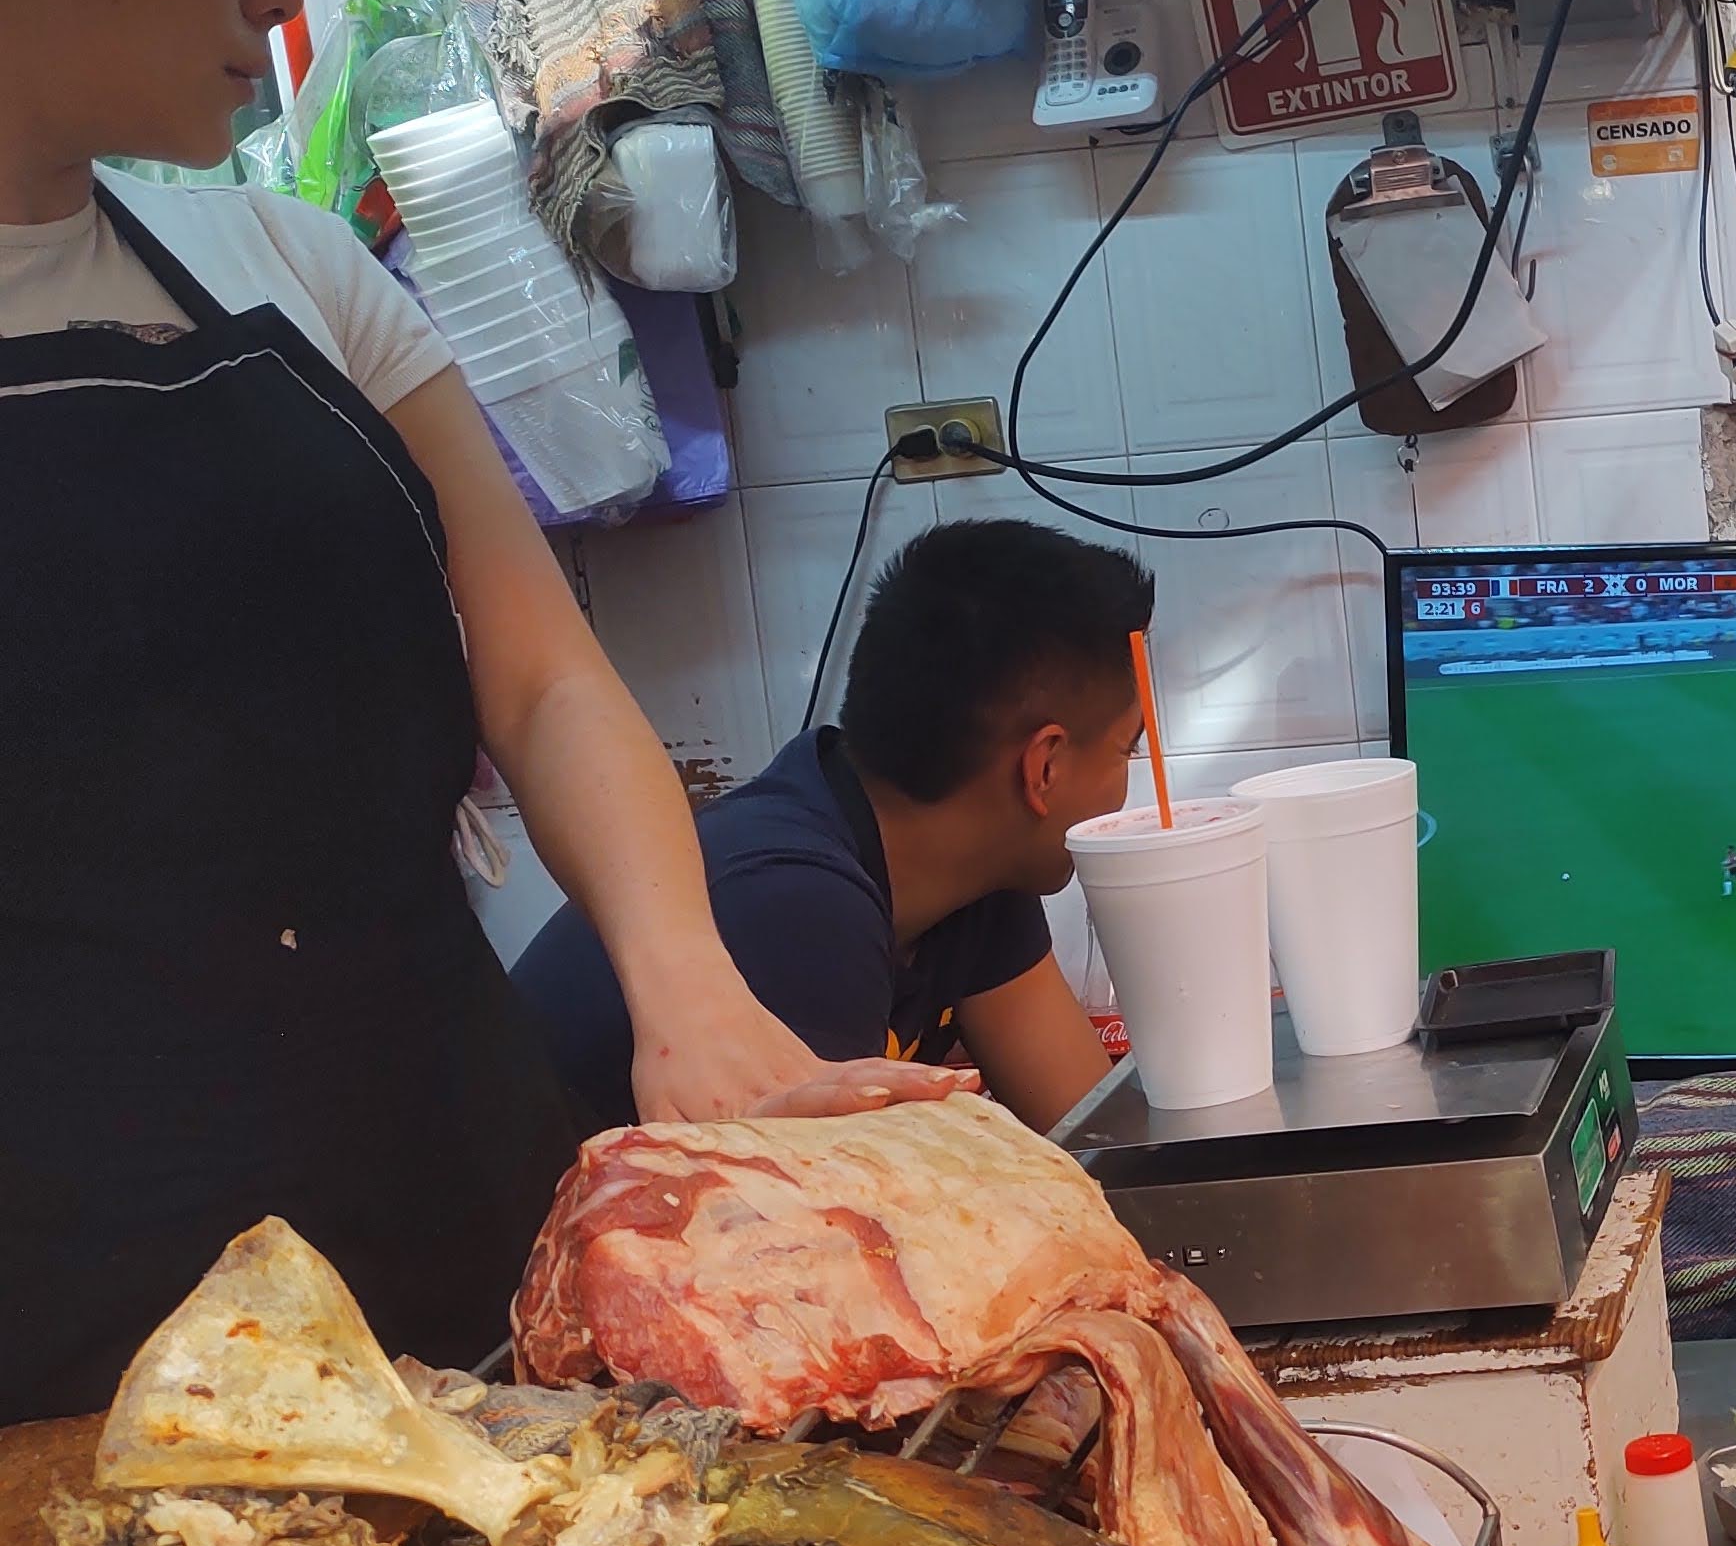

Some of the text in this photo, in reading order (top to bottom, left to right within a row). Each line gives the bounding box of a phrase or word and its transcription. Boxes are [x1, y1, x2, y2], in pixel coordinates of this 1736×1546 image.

[1266, 69, 1413, 118] EXTINTOR
[1596, 119, 1692, 141] CENSADO
[1431, 576, 1698, 597] 93:39 FRA 2 0 MOR
[1423, 602, 1481, 616] 2:21 6
